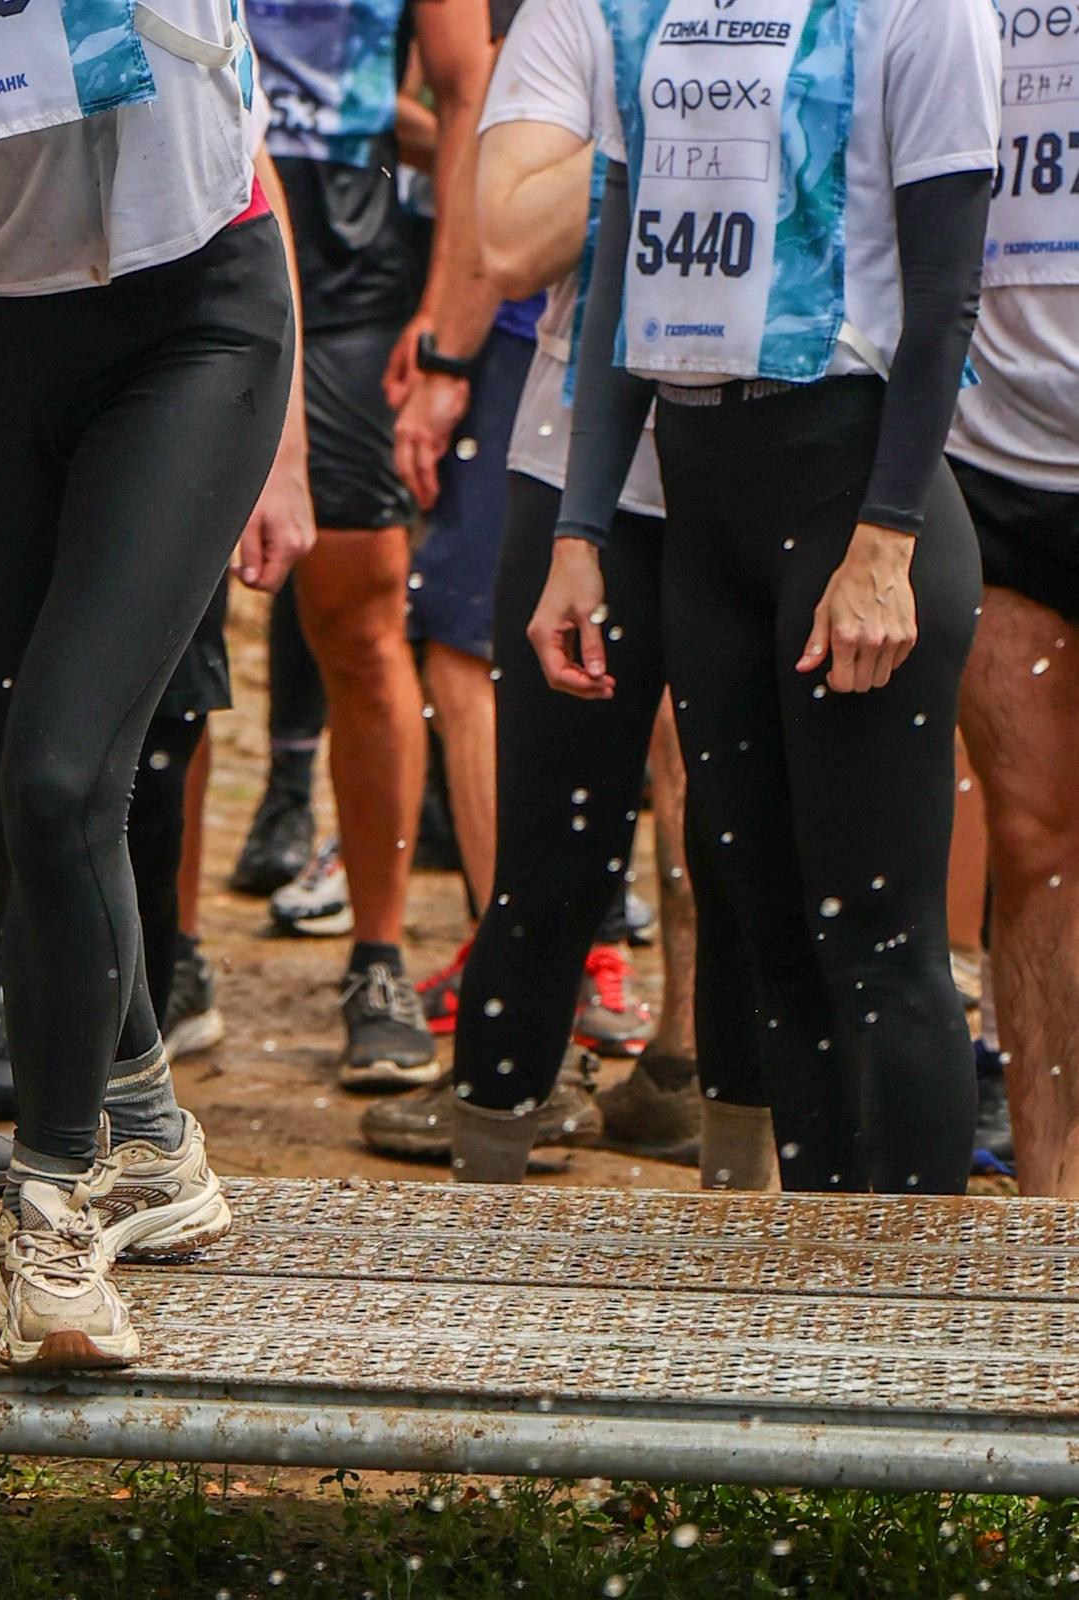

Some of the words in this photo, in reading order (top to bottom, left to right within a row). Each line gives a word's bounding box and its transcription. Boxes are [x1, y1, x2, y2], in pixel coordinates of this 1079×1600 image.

[662, 20, 709, 38] ГОНКА
[715, 20, 791, 39] ГЕРОЕВ
[998, 6, 1079, 48] pe
[655, 145, 722, 176] ИРА
[636, 210, 755, 277] 5440
